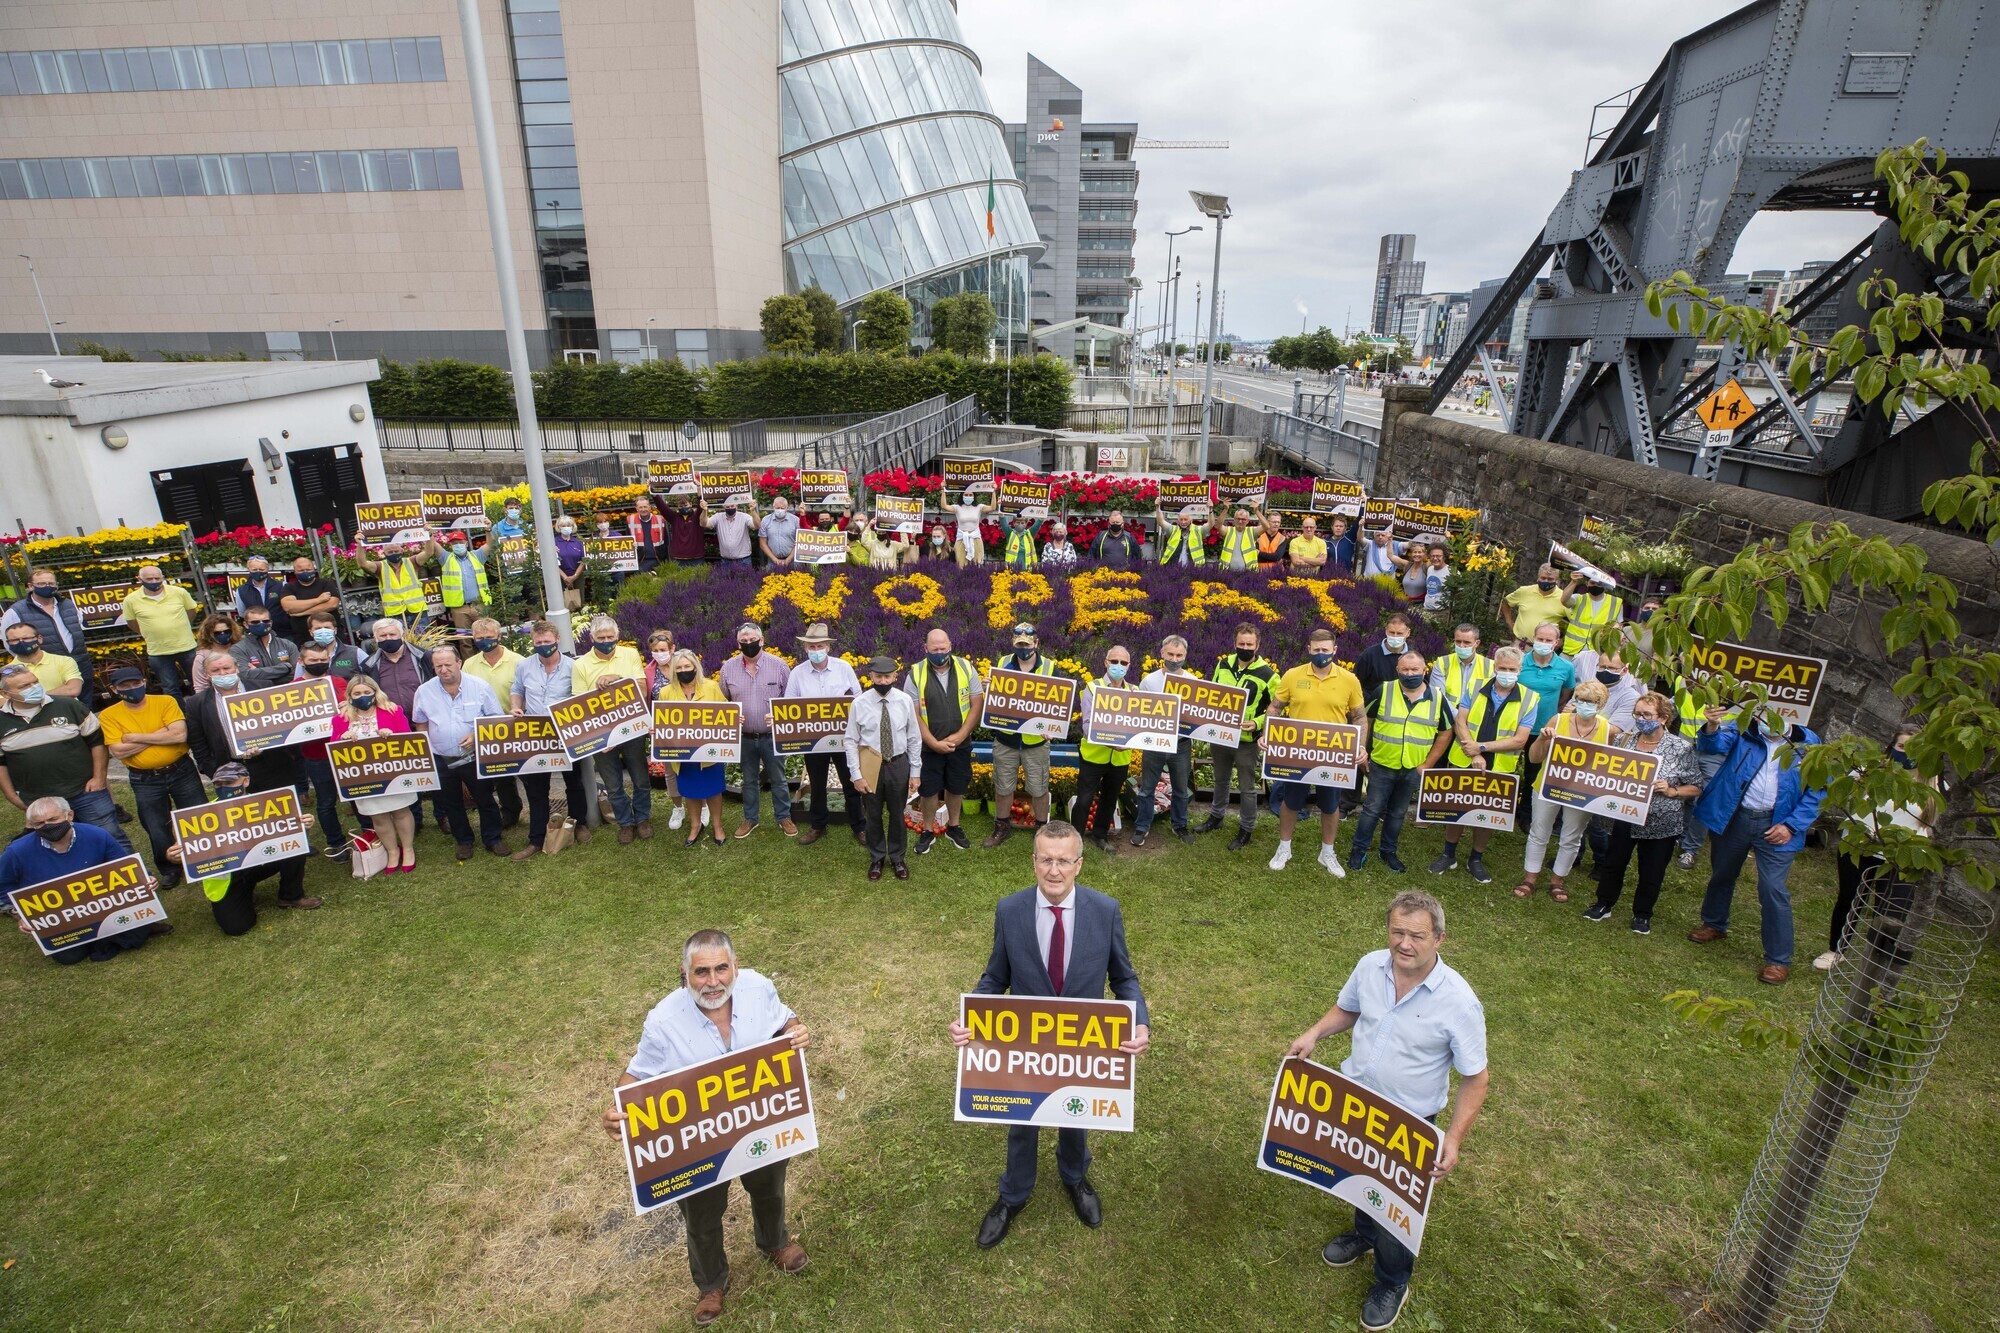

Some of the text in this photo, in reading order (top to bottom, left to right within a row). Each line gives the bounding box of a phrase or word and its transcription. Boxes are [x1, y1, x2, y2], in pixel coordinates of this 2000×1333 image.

[1037, 132, 1060, 144] pwc
[1708, 434, 1729, 443] 50m
[649, 463, 690, 474] NO PEAT
[945, 462, 992, 473] NO PEAT
[660, 473, 693, 482] PRODUCE
[702, 474, 746, 485] NO PEAT
[802, 474, 844, 484] NO PEAT
[957, 473, 992, 481] PRODUCE
[1220, 475, 1266, 486] NO PEAT
[714, 484, 749, 493] PRODUCE
[814, 484, 847, 492] PRODUCE
[1003, 484, 1047, 497] NO PEAT
[1161, 485, 1207, 495] NO PEAT
[1231, 485, 1265, 493] PRODUCE
[1316, 482, 1360, 495] NO PEAT
[424, 493, 479, 505] NO PEAT
[878, 500, 921, 512] NO PEAT
[1002, 494, 1047, 506] NO PRODUCE
[1314, 492, 1360, 504] NO PRODUCE
[359, 504, 419, 520] NO PEAT
[425, 505, 482, 515] NO PRODUCE
[878, 510, 921, 521] NO PRODUCE
[1396, 508, 1412, 520] NO
[1416, 512, 1446, 525] PEAT
[361, 522, 376, 530] NO
[377, 517, 423, 529] PRODUCE
[1395, 518, 1405, 527] NO
[1408, 521, 1444, 534] PRODUCE
[604, 540, 633, 550] PEAT
[797, 543, 845, 552] NO PRODUCE
[798, 534, 844, 545] NO PEAT
[743, 567, 1356, 632] NO PEAT
[1689, 643, 1817, 686] NO PEAT
[991, 676, 1071, 702] NO PEAT
[1165, 681, 1244, 710] NO PEAT
[229, 685, 325, 718] NO PEAT
[554, 683, 635, 726] NO PEAT
[988, 694, 1006, 707] NO
[1008, 698, 1068, 717] PRODUCE
[1096, 694, 1176, 716] NO PEAT
[234, 702, 335, 732] NO PRODUCE
[562, 701, 643, 740] NO PRODUCE
[656, 709, 738, 726] NO PEAT
[774, 704, 801, 720] NO
[1181, 703, 1240, 725] PRODUCE
[775, 720, 847, 734] NO PRODUC
[1048, 722, 1064, 732] IFA
[1094, 712, 1174, 731] NO PRODUCE
[479, 721, 555, 741] NO PEA
[655, 728, 737, 740] NO PRODUCE
[1269, 725, 1355, 750] NO PEAT
[480, 739, 565, 756] NO PRODUCE
[1156, 737, 1172, 747] IFA
[333, 739, 425, 765] NO PEAT
[720, 748, 735, 756] IFA
[1268, 745, 1353, 765] NO PRODUCE
[337, 758, 431, 779] NO PRODUCE
[1552, 744, 1654, 780] NO PEAT
[415, 777, 433, 787] IFA
[1334, 772, 1350, 782] IFA
[1424, 775, 1514, 796] NO PEAT
[1549, 764, 1648, 798] NO PRODUCE
[1423, 793, 1511, 810] NO PRODUCE
[1619, 803, 1640, 817] IFA
[179, 795, 292, 837] NO PEAT
[185, 817, 299, 855] NO PRODUCE
[279, 838, 300, 852] IFA
[19, 864, 137, 916] NO PEAT
[31, 885, 149, 930] NO PRODUCE
[133, 906, 156, 921] IFA
[968, 1009, 1128, 1049] NO PEAT
[966, 1047, 1125, 1081] NO PRODUCE
[626, 1050, 795, 1138] NO PEAT
[989, 1095, 1032, 1106] ASSOCIATION.
[971, 1104, 1009, 1113] YOUR VOICE.
[1092, 1099, 1122, 1118] IFA
[634, 1087, 802, 1168] NO PRODUCE
[1279, 1069, 1434, 1170] NO PEAT
[774, 1127, 805, 1150] IFA
[1273, 1105, 1425, 1204] NO PRODUCE
[1276, 1149, 1336, 1177] YOUR ASSOCIATION.
[1275, 1156, 1312, 1175] YOUR VOICE.
[650, 1162, 715, 1192] YOUR ASSOCIATION.
[651, 1179, 694, 1199] YOUR VOICE.
[1387, 1202, 1411, 1236] IFA
